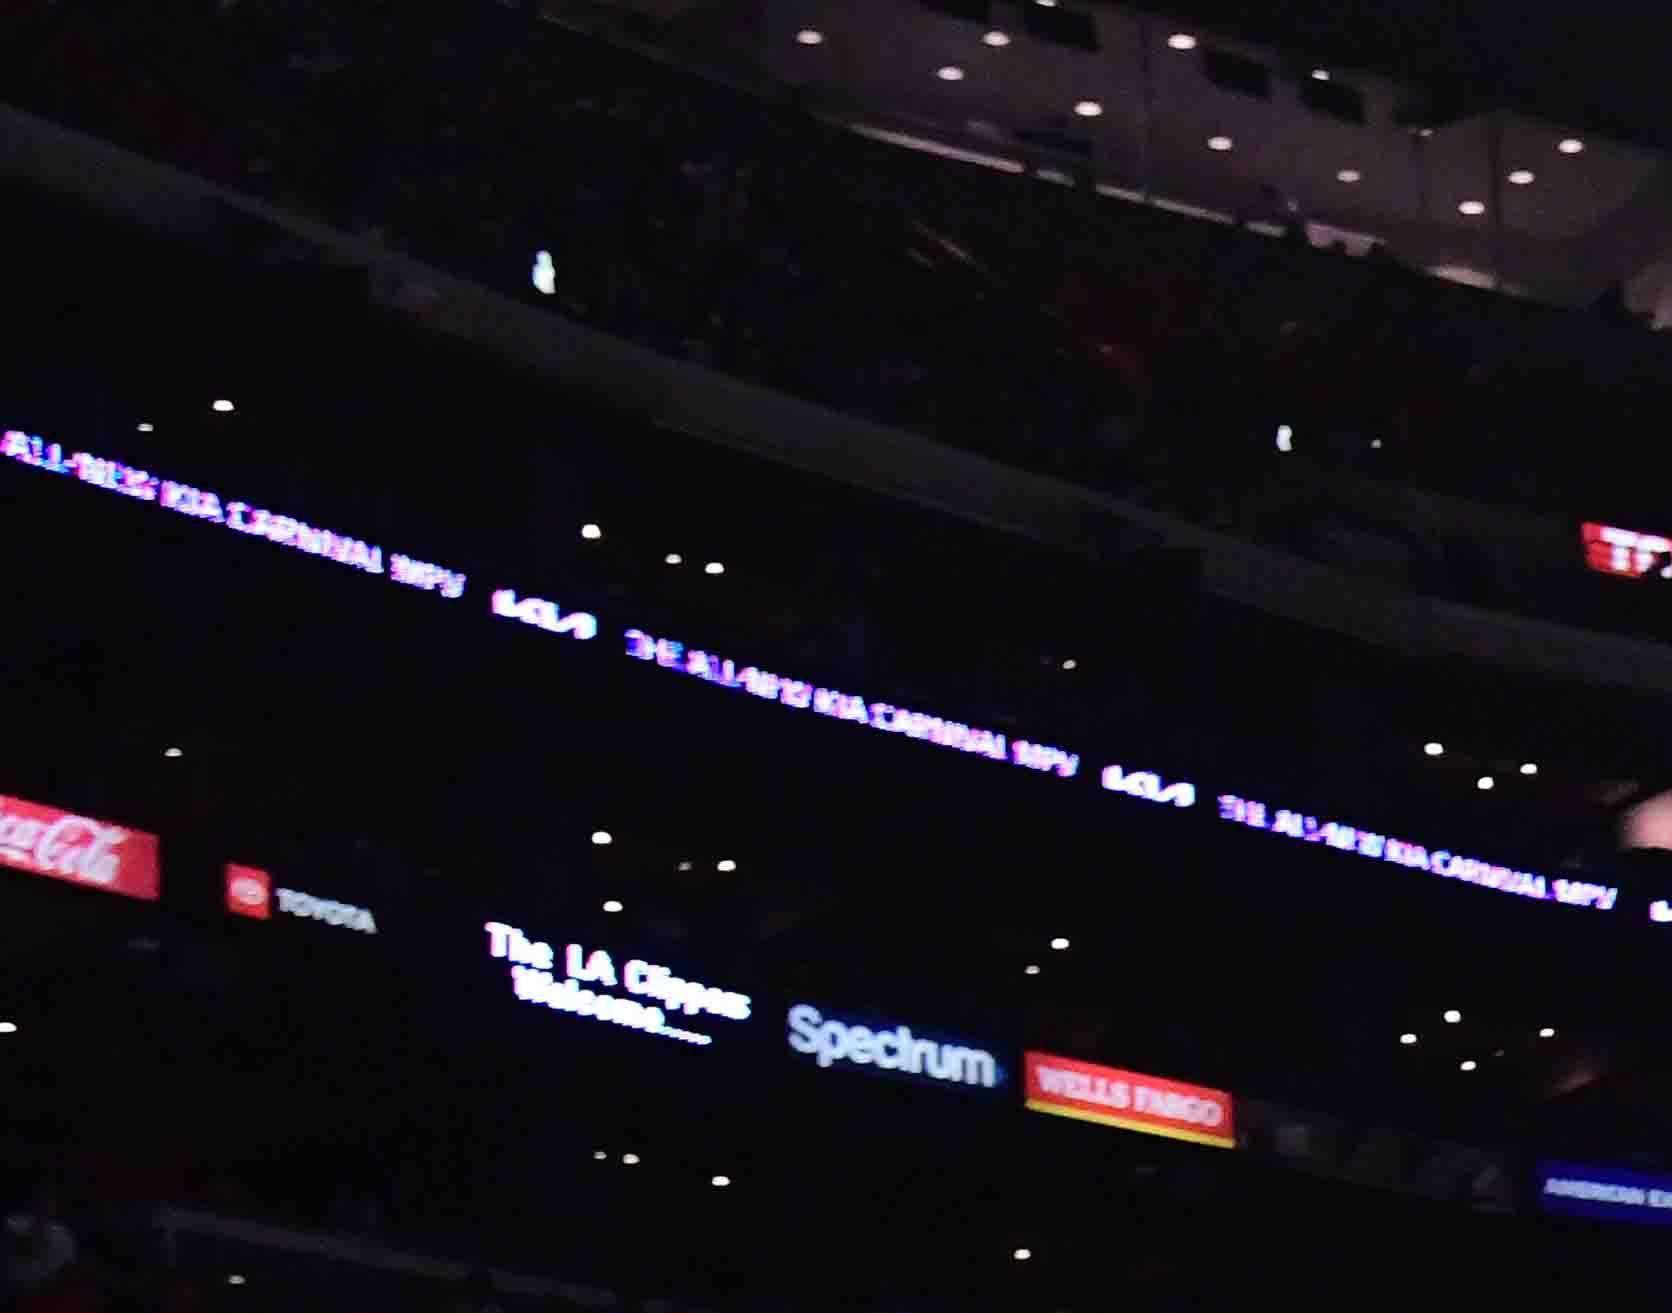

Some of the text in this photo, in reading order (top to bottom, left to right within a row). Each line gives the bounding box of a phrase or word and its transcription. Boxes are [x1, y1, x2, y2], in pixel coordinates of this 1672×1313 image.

[275, 888, 378, 935] TOYOTA
[485, 921, 553, 969] The
[566, 944, 617, 986] LA
[788, 1004, 997, 1088] Spectrum
[1036, 1065, 1224, 1128] WELLS FARGO
